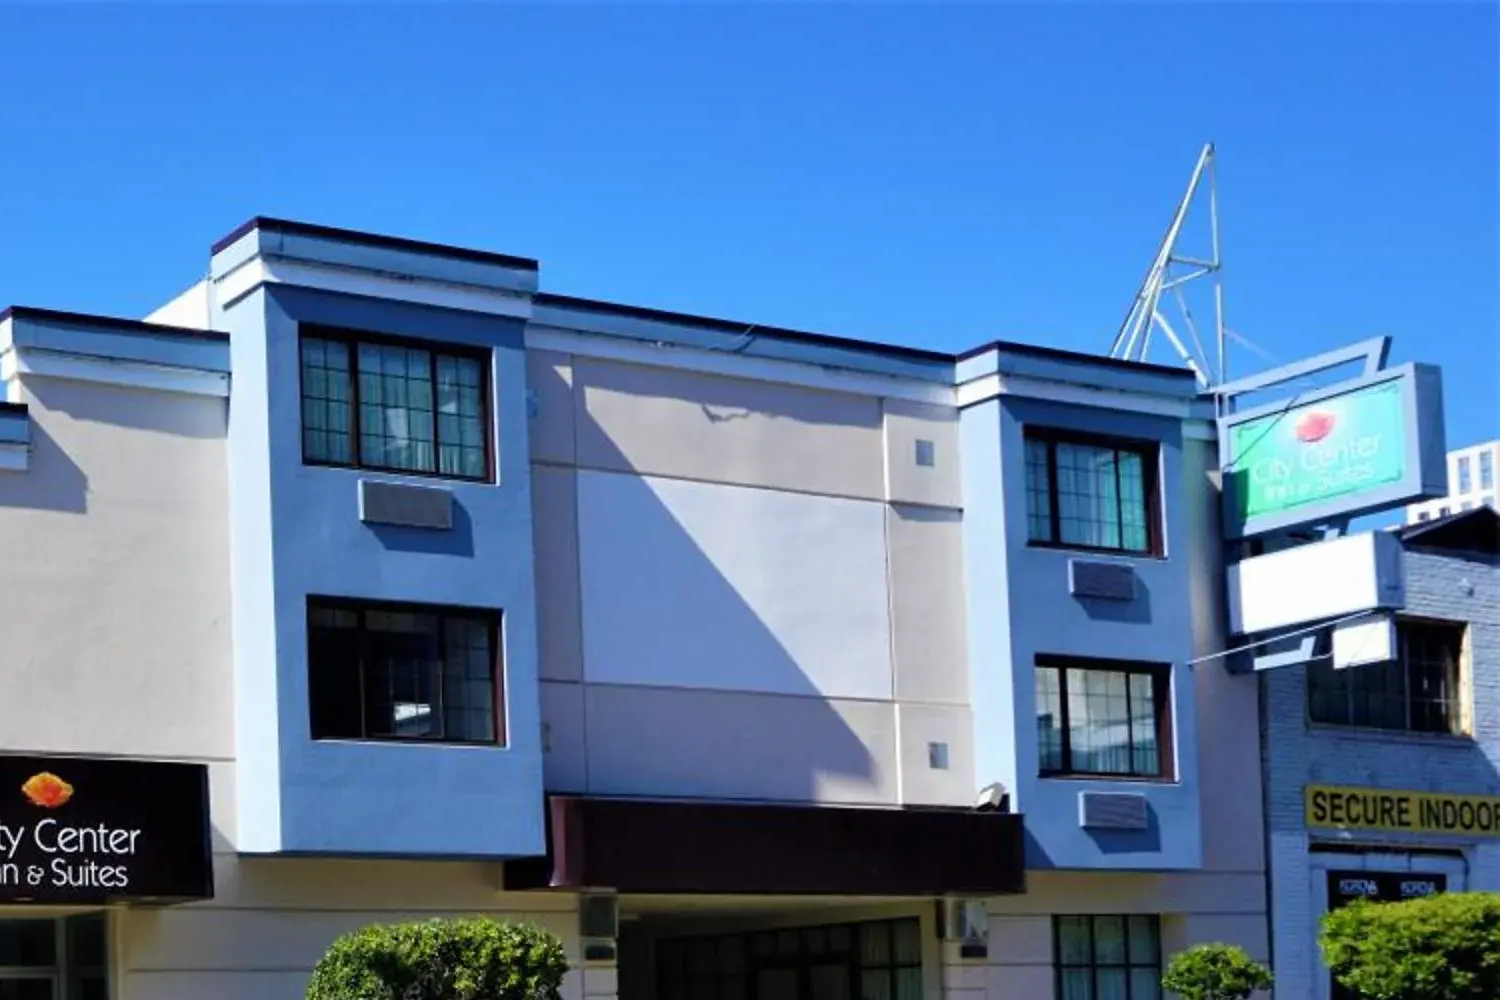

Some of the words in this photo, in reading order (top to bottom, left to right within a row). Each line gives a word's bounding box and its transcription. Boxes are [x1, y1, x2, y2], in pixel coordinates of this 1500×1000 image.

[1253, 456, 1293, 484] City
[1301, 434, 1382, 471] Center
[1312, 791, 1411, 827] SECURE
[34, 818, 142, 854] Center
[27, 865, 44, 885] &
[51, 858, 129, 887] Suites
